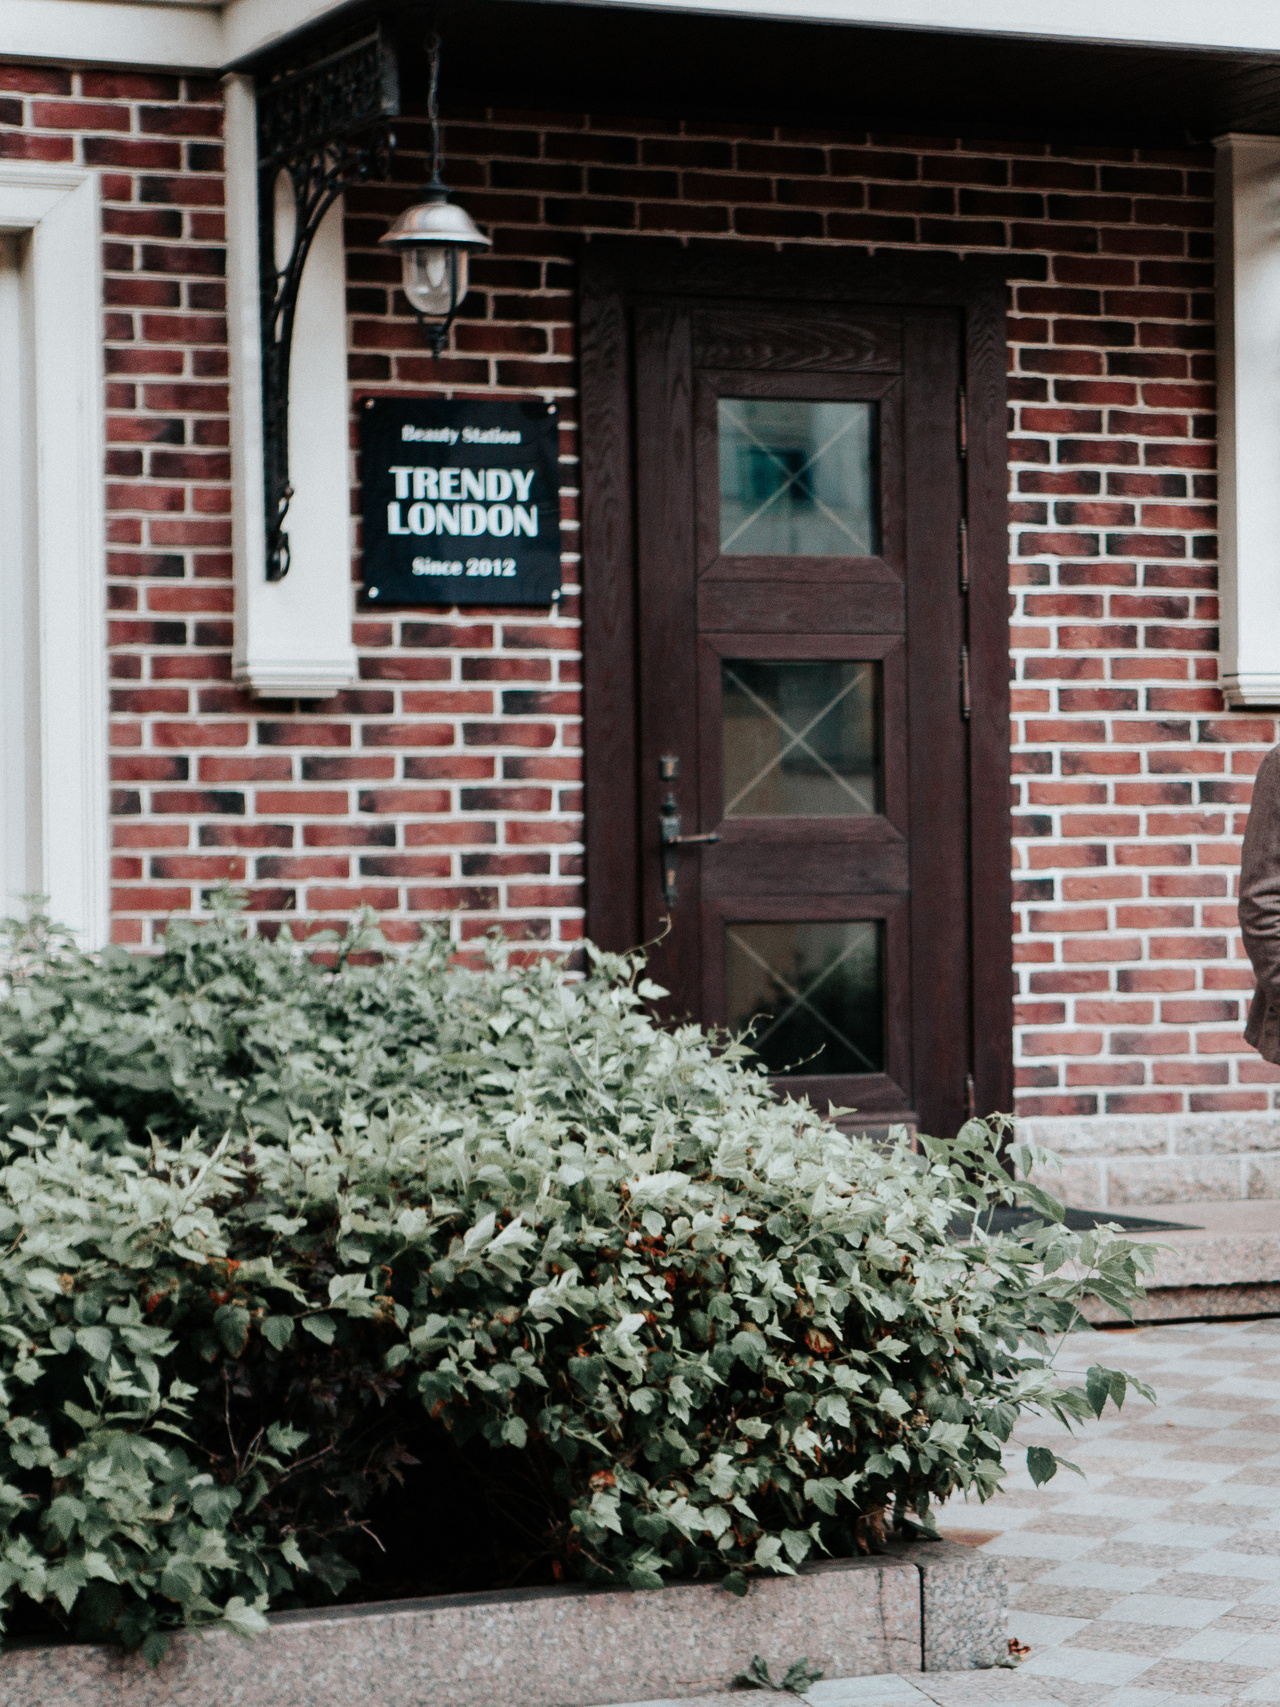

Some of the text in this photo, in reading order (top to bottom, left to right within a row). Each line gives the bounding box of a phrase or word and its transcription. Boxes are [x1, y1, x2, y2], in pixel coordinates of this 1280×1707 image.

[401, 424, 522, 446] Beauty Station
[388, 466, 535, 502] TRENDY
[387, 502, 539, 538] LONDON
[412, 556, 517, 577] Since 2012
